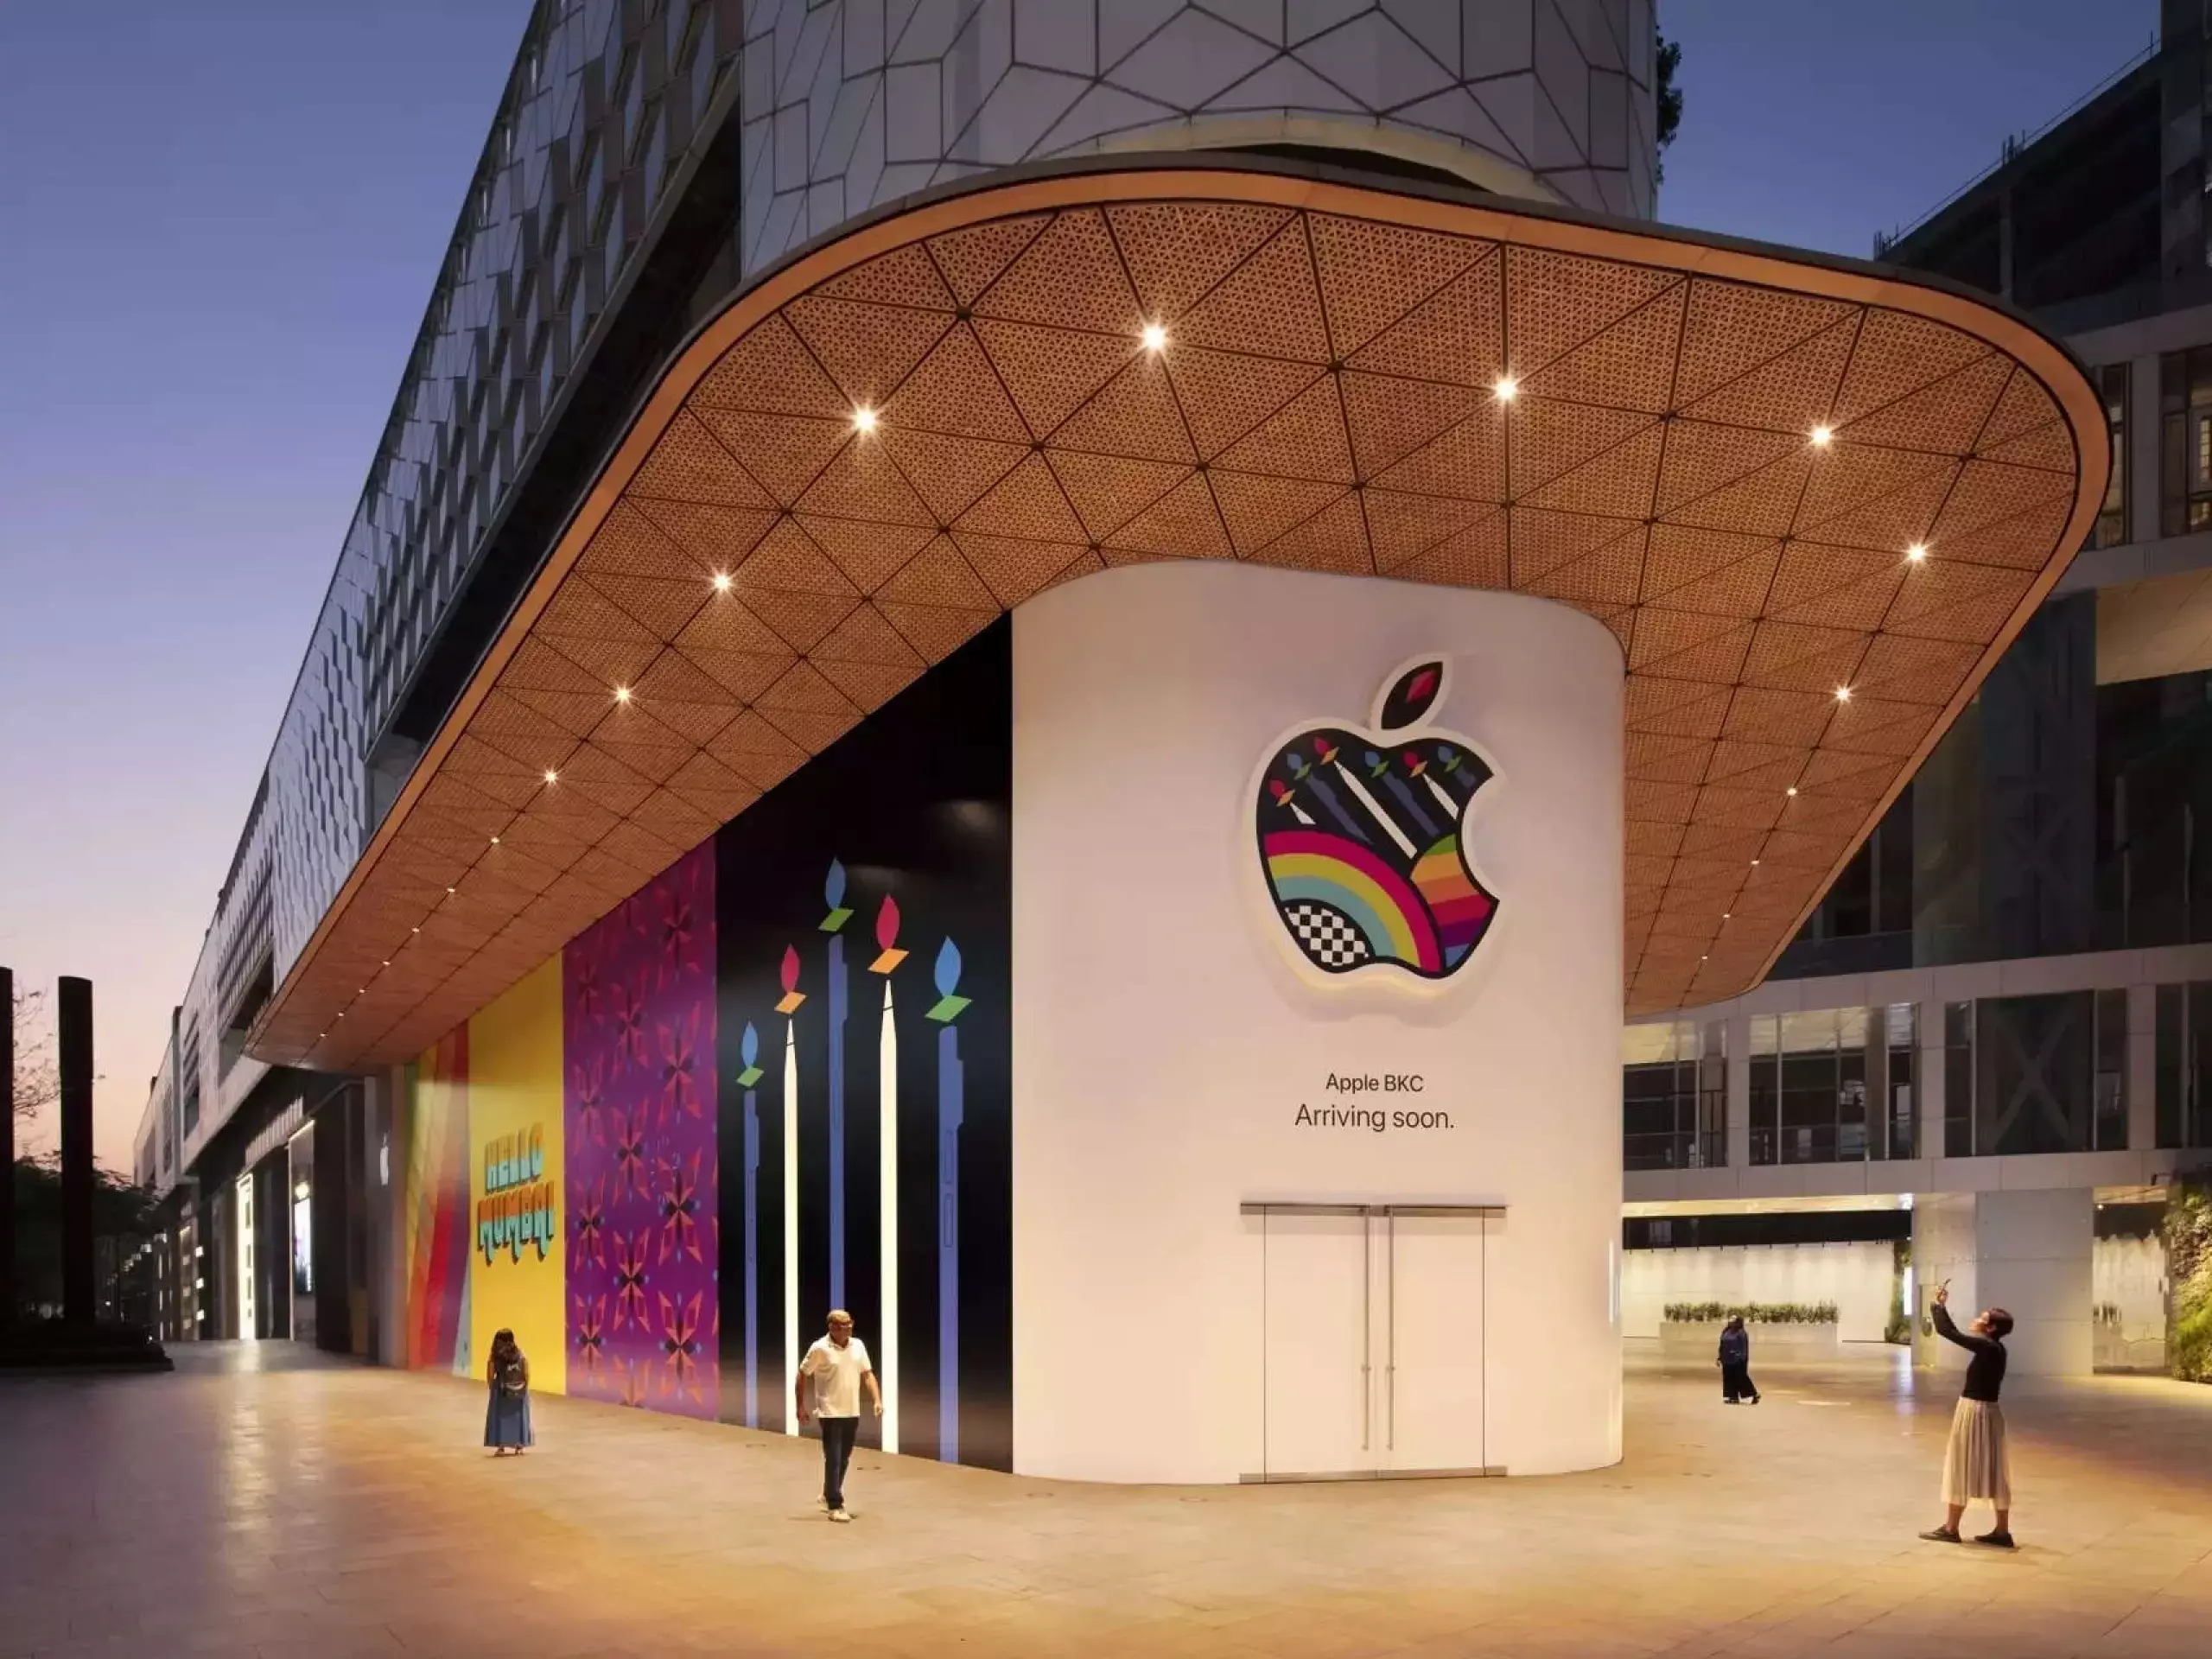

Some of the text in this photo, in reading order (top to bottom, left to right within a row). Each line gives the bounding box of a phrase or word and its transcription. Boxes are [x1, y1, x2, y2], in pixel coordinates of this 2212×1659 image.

[1325, 1072, 1424, 1094] Apple BKC
[1294, 1103, 1454, 1132] Arriving soon.
